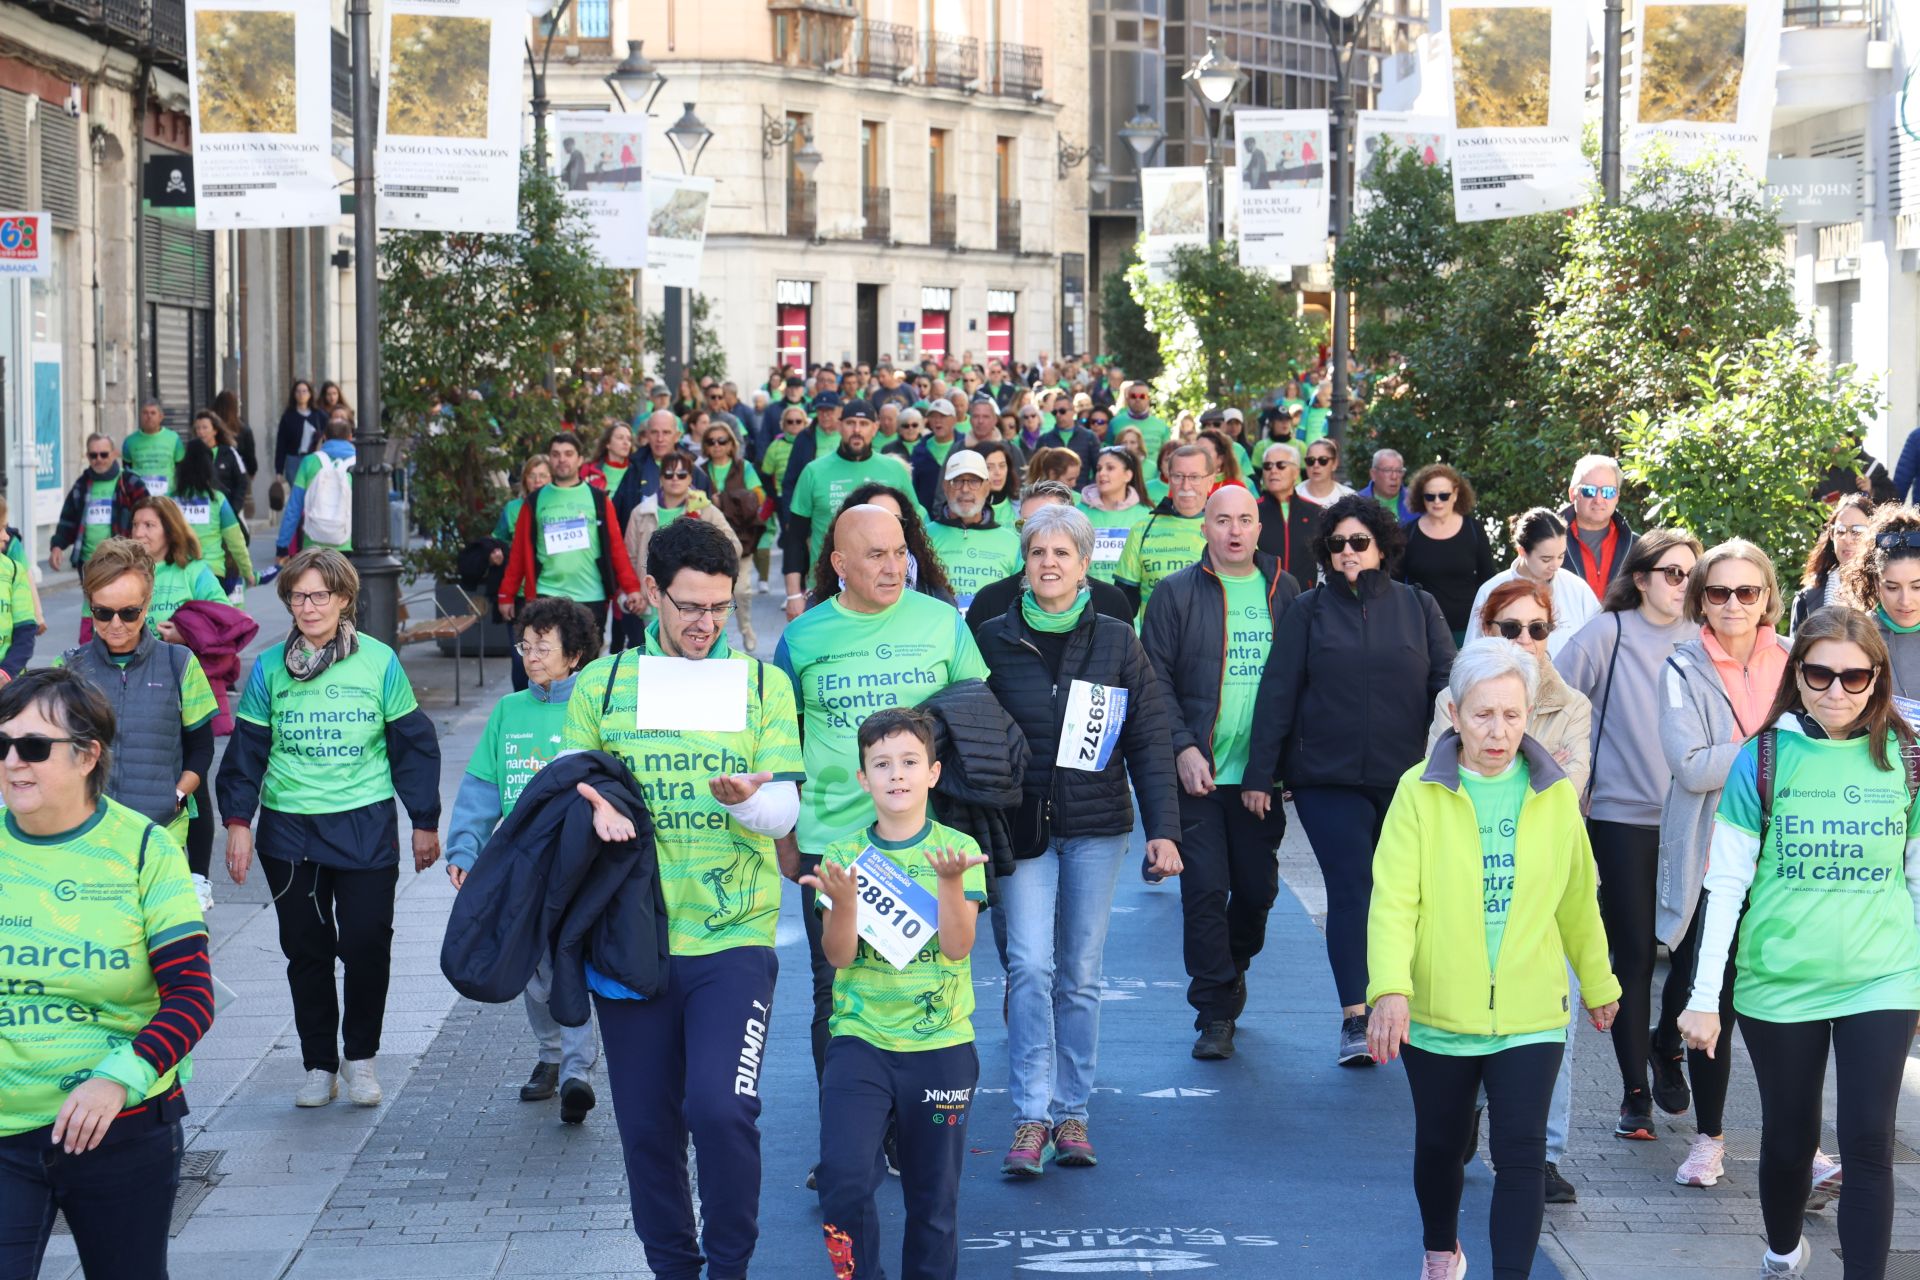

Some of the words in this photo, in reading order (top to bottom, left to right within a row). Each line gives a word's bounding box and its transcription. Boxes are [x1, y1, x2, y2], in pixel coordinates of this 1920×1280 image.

[1768, 183, 1803, 196] DAN
[1808, 183, 1853, 197] JOHN
[550, 530, 583, 542] 11203
[954, 566, 1004, 578] marcha
[1142, 558, 1162, 573] En
[950, 576, 977, 588] ntra
[1233, 630, 1272, 642] marc
[831, 650, 870, 660] Iberdrola
[1226, 646, 1260, 659] ntra
[826, 674, 851, 690] En
[858, 667, 937, 688] marcha
[826, 690, 898, 710] contra
[284, 710, 304, 724] En
[310, 708, 376, 722] marcha
[834, 712, 851, 728] el
[284, 726, 342, 741] contra
[606, 732, 621, 742] XIII
[624, 730, 681, 740] Valladolid
[287, 743, 303, 756] el
[305, 742, 365, 758] cáncer
[506, 742, 518, 755] En
[644, 748, 748, 774] marcha
[641, 778, 696, 801] ntra
[1792, 788, 1836, 798] Iberdrola
[1785, 815, 1814, 834] En
[1822, 816, 1904, 836] marcha
[1784, 840, 1864, 858] contra
[870, 852, 882, 863] XIV
[881, 859, 912, 888] Valladolid
[1786, 862, 1806, 880] el
[1812, 862, 1892, 882] cáncer
[862, 862, 881, 878] contra
[886, 880, 904, 896] cáncer
[856, 874, 921, 939] 28810
[0, 914, 32, 928] dolid
[0, 1000, 102, 1028] áncer
[735, 1018, 766, 1098] PUMA
[921, 1088, 972, 1104] NINJAGO
[992, 1226, 1222, 1238] VALLADOLID
[960, 1234, 1280, 1250] SEMINC
